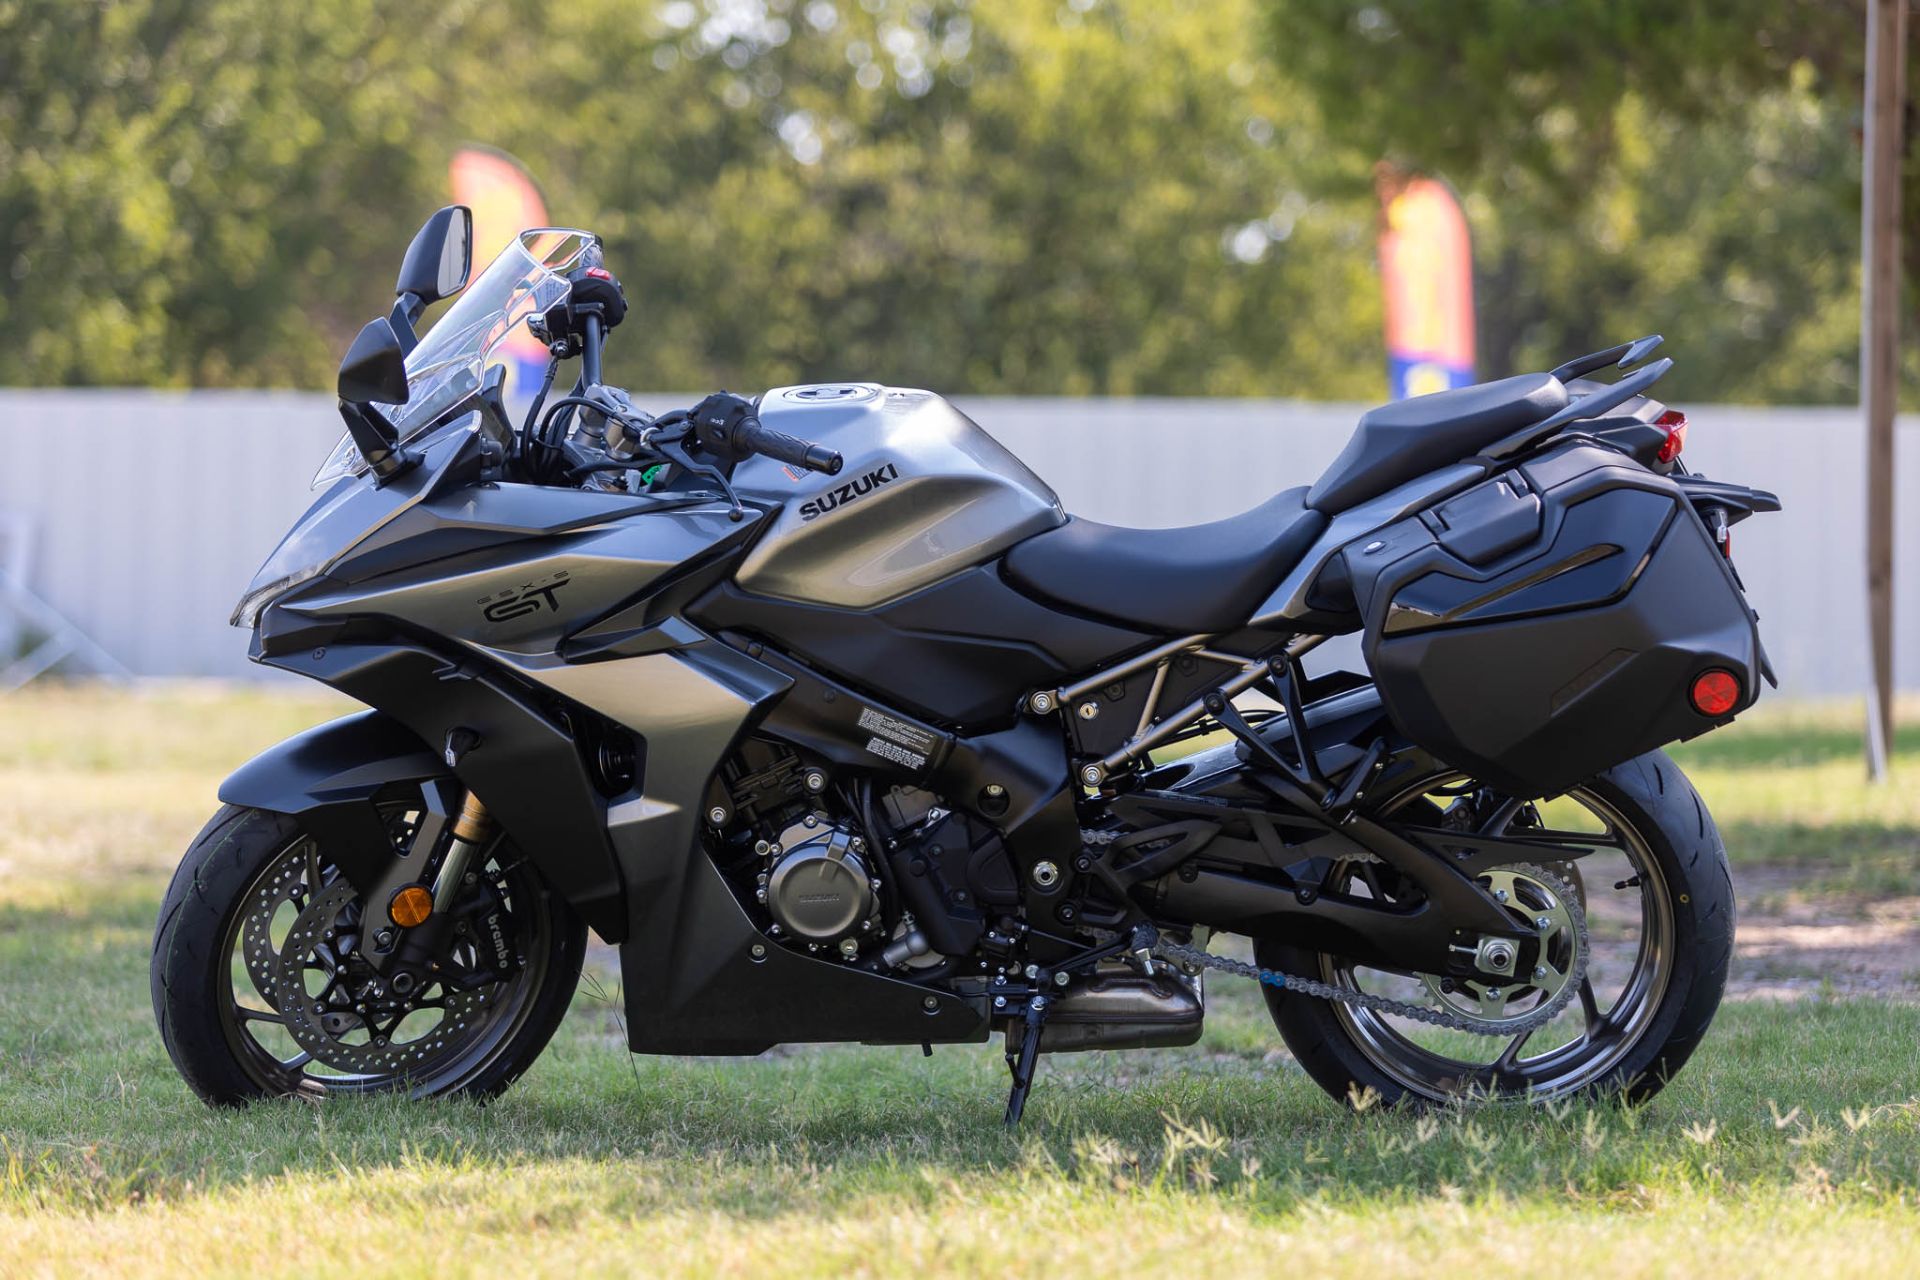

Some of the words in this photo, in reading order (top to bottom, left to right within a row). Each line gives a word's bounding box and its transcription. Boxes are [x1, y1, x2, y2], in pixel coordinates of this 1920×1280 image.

[799, 463, 899, 521] SUZUKI
[484, 578, 571, 622] GT
[488, 913, 509, 969] brembo
